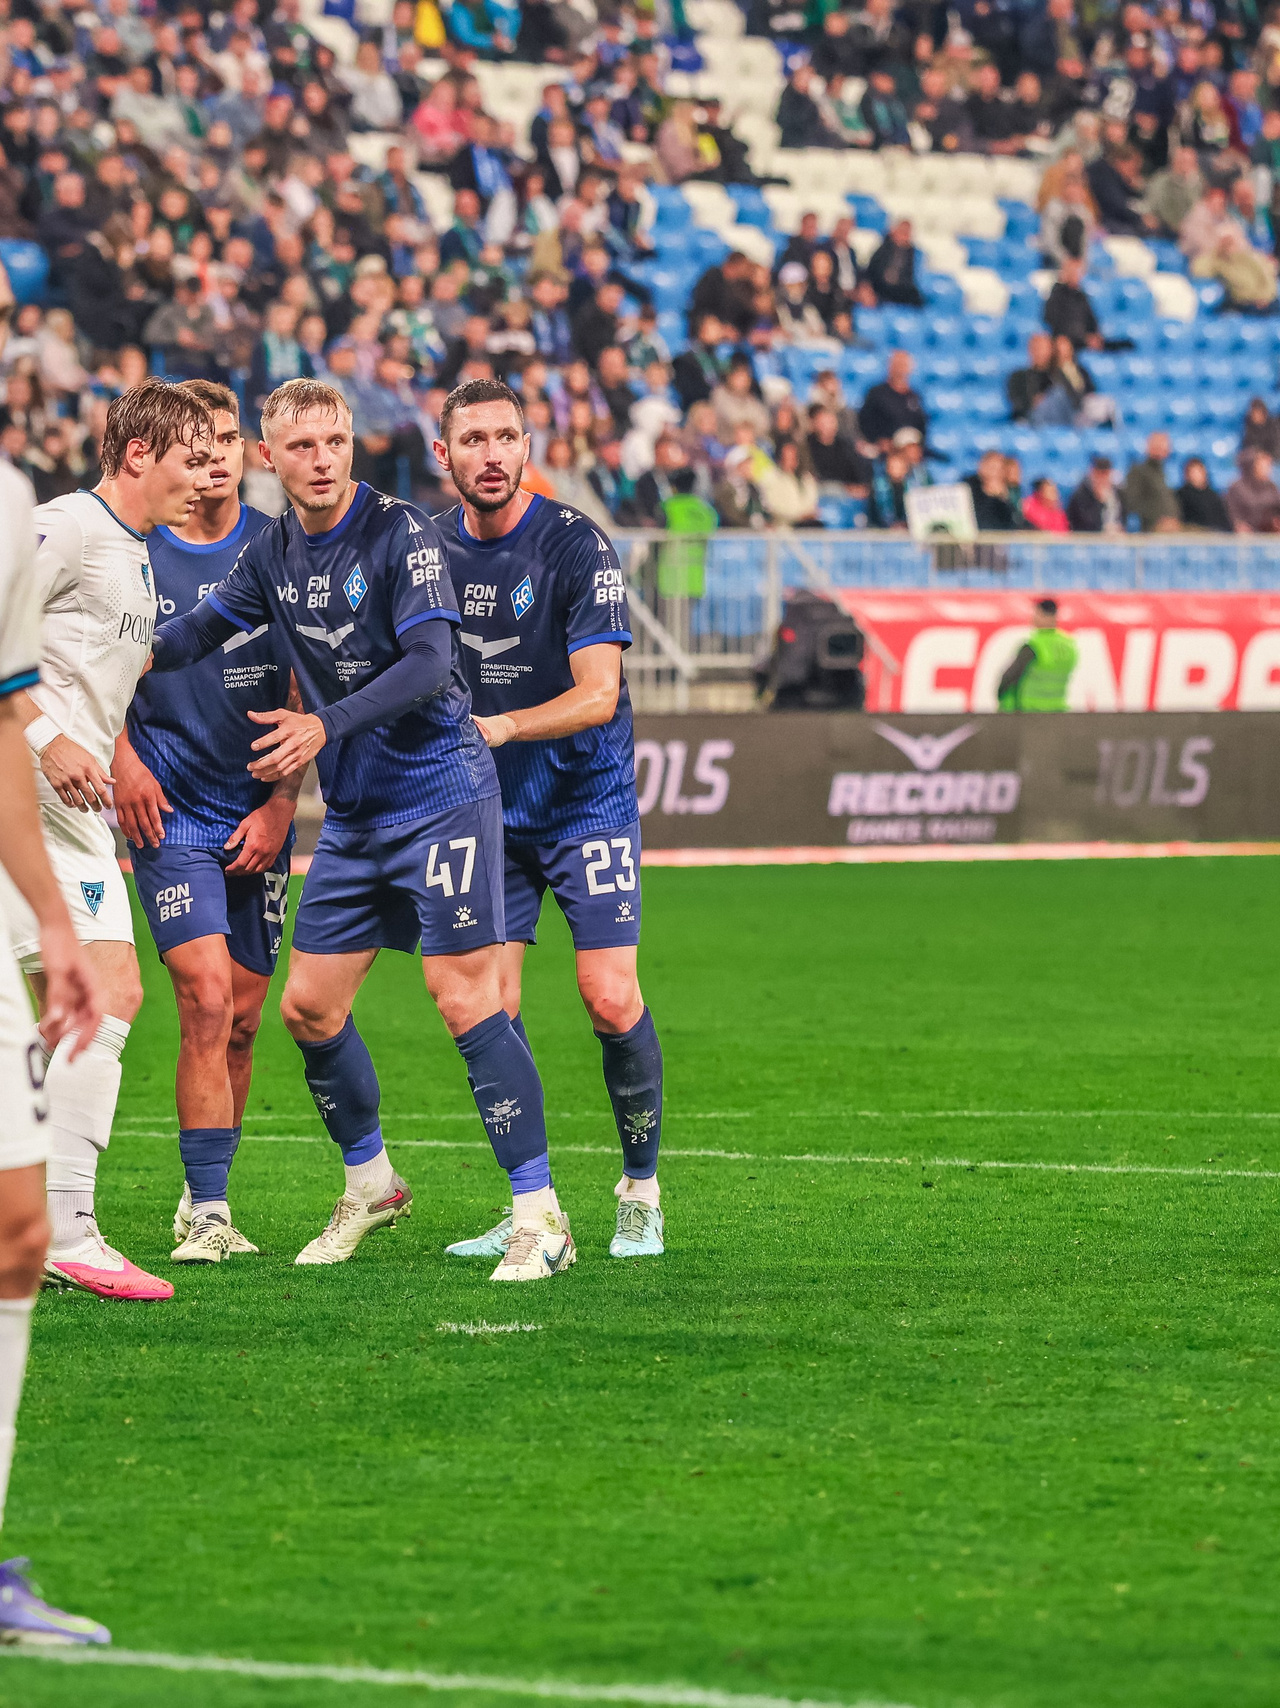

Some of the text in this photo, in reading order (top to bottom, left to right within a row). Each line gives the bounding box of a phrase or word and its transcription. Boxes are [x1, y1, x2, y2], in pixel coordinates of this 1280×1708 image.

[406, 547, 439, 570] FON
[412, 564, 442, 587] BET
[594, 569, 623, 587] FON
[464, 583, 497, 600] FON
[595, 585, 625, 604] BET
[156, 594, 176, 615] b
[464, 600, 497, 617] BET
[480, 663, 533, 673] ПРАВИТЕЛЬСТВО
[480, 670, 519, 679] САМАРСКОЙ
[224, 680, 259, 689] ОБЛАСТИ
[480, 677, 512, 685] ОБЛАСТИ
[827, 771, 1020, 817] RECORD
[425, 836, 477, 898] 47
[581, 837, 636, 896] 23
[155, 882, 190, 907] FON
[160, 897, 194, 923] BET
[452, 918, 478, 930] KELME
[614, 915, 635, 924] KELME
[631, 1133, 648, 1144] 23
